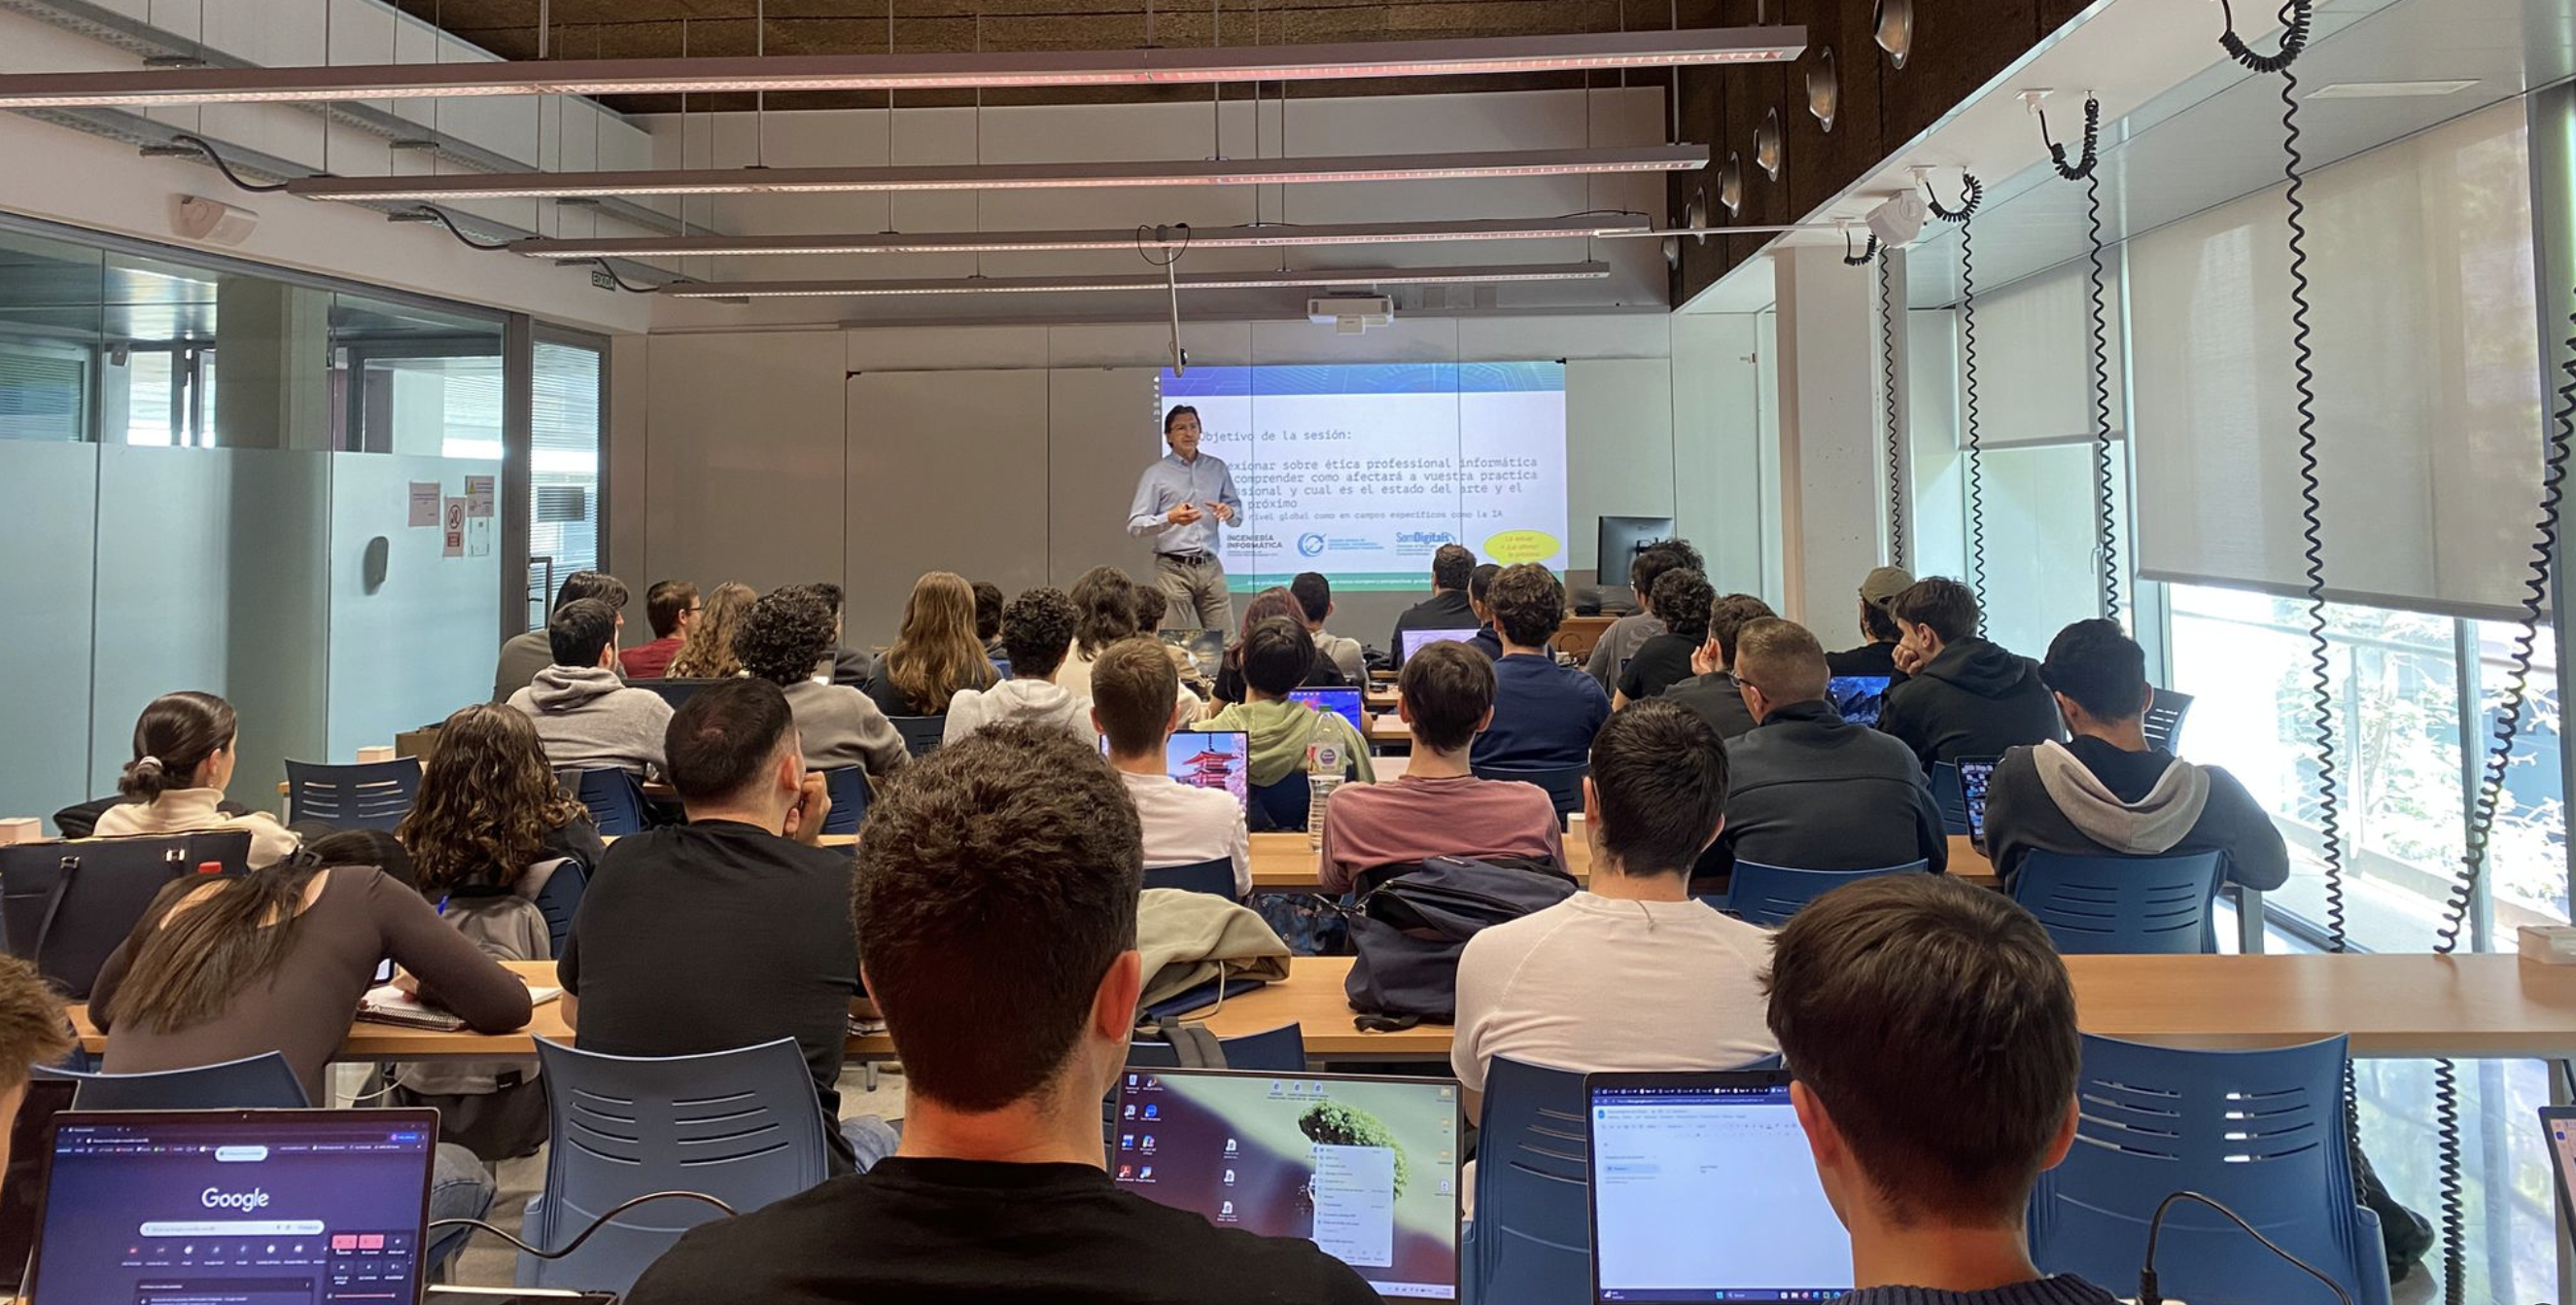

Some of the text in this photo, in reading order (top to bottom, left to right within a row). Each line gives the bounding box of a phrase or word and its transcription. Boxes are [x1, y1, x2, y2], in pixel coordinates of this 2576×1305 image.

[1261, 431, 1275, 441] de
[1283, 431, 1297, 441] la
[1304, 430, 1352, 441] sesión:
[1283, 460, 1318, 470] sobre
[1325, 459, 1360, 470] ética
[1460, 457, 1538, 468] informática
[1234, 473, 1305, 484] comprender
[1311, 474, 1340, 482] como
[1346, 472, 1403, 482] afectará
[1424, 472, 1474, 481] vuestra
[1290, 487, 1298, 497] y
[1304, 485, 1332, 495] cual
[1361, 485, 1374, 494] el
[1381, 484, 1424, 494] estado
[1431, 483, 1452, 494] del
[1460, 484, 1488, 494] arte
[1495, 485, 1502, 495] y
[1509, 482, 1522, 493] el
[1248, 498, 1298, 511] próximo
[1279, 511, 1308, 520] global
[201, 1187, 269, 1213] Google
